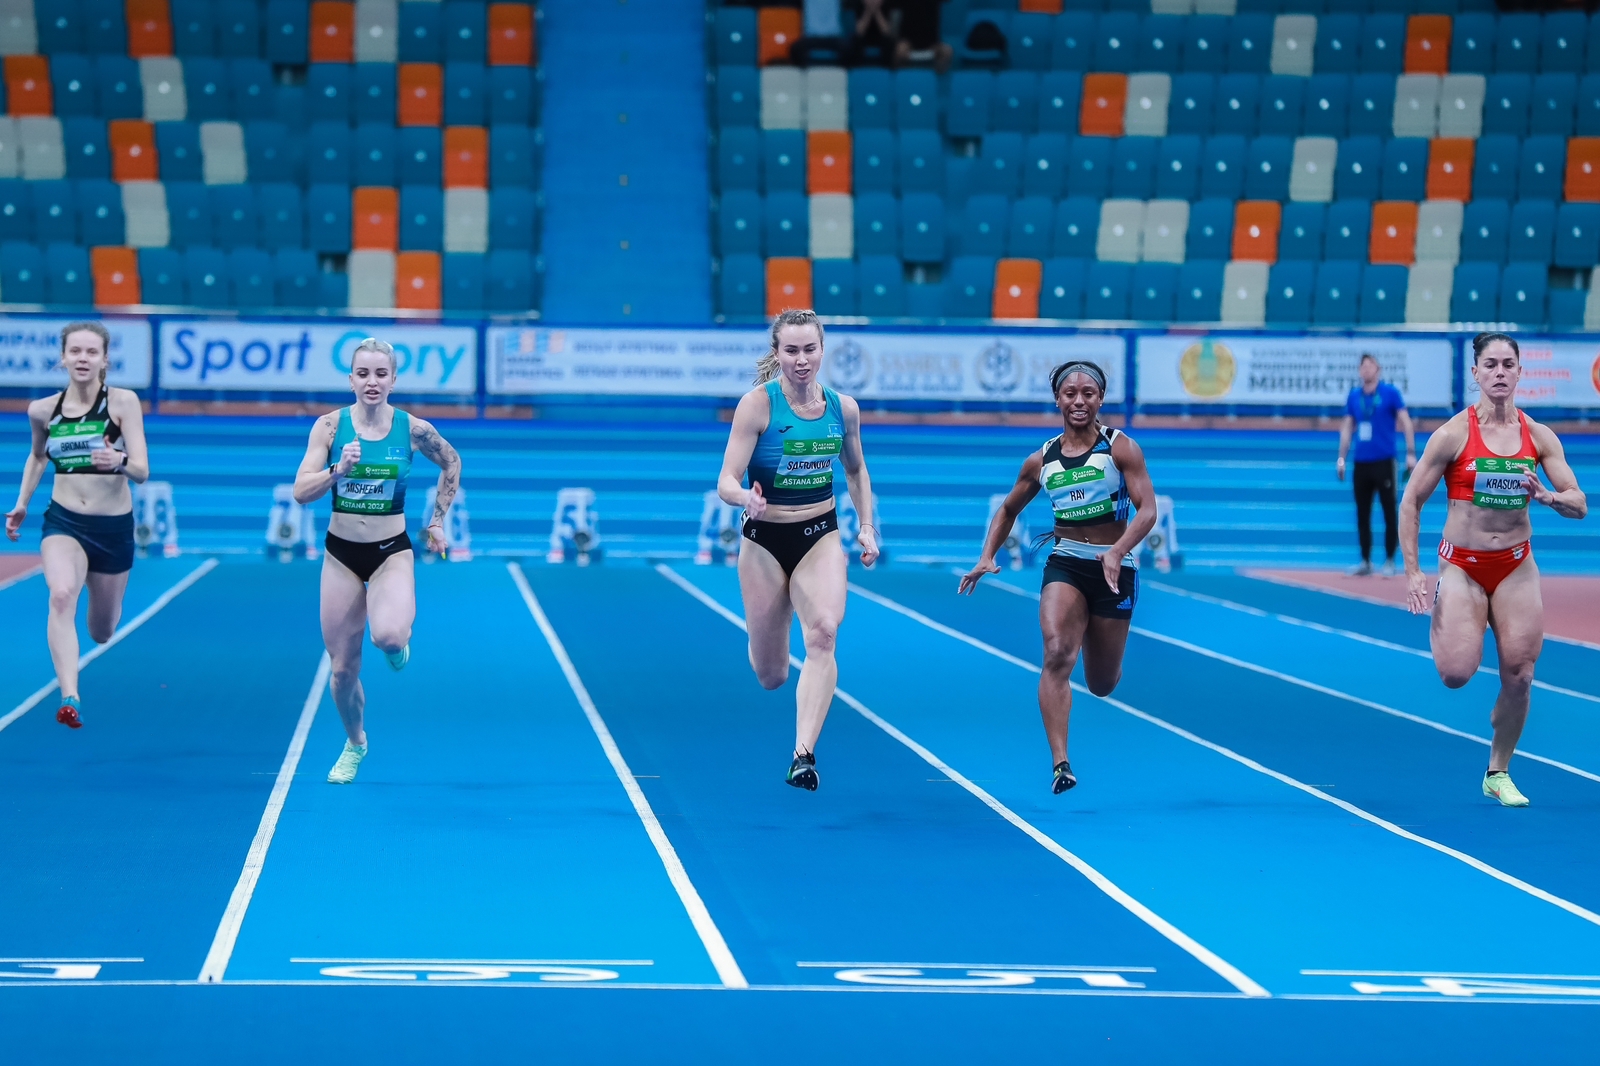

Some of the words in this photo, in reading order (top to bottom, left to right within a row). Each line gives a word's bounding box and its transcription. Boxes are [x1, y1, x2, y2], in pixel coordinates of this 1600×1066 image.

[171, 329, 311, 381] Sport
[332, 330, 465, 386] Gory
[782, 478, 811, 486] ASTANA
[812, 476, 827, 485] 2023
[345, 482, 384, 495] MISHEEVA
[1070, 488, 1085, 502] RAY
[340, 500, 366, 509] ASTANA
[367, 502, 385, 510] 2023
[1480, 496, 1508, 505] ASTANA
[1061, 509, 1087, 519] ASTANA
[1087, 504, 1105, 515] 2023
[804, 521, 828, 536] QAZ
